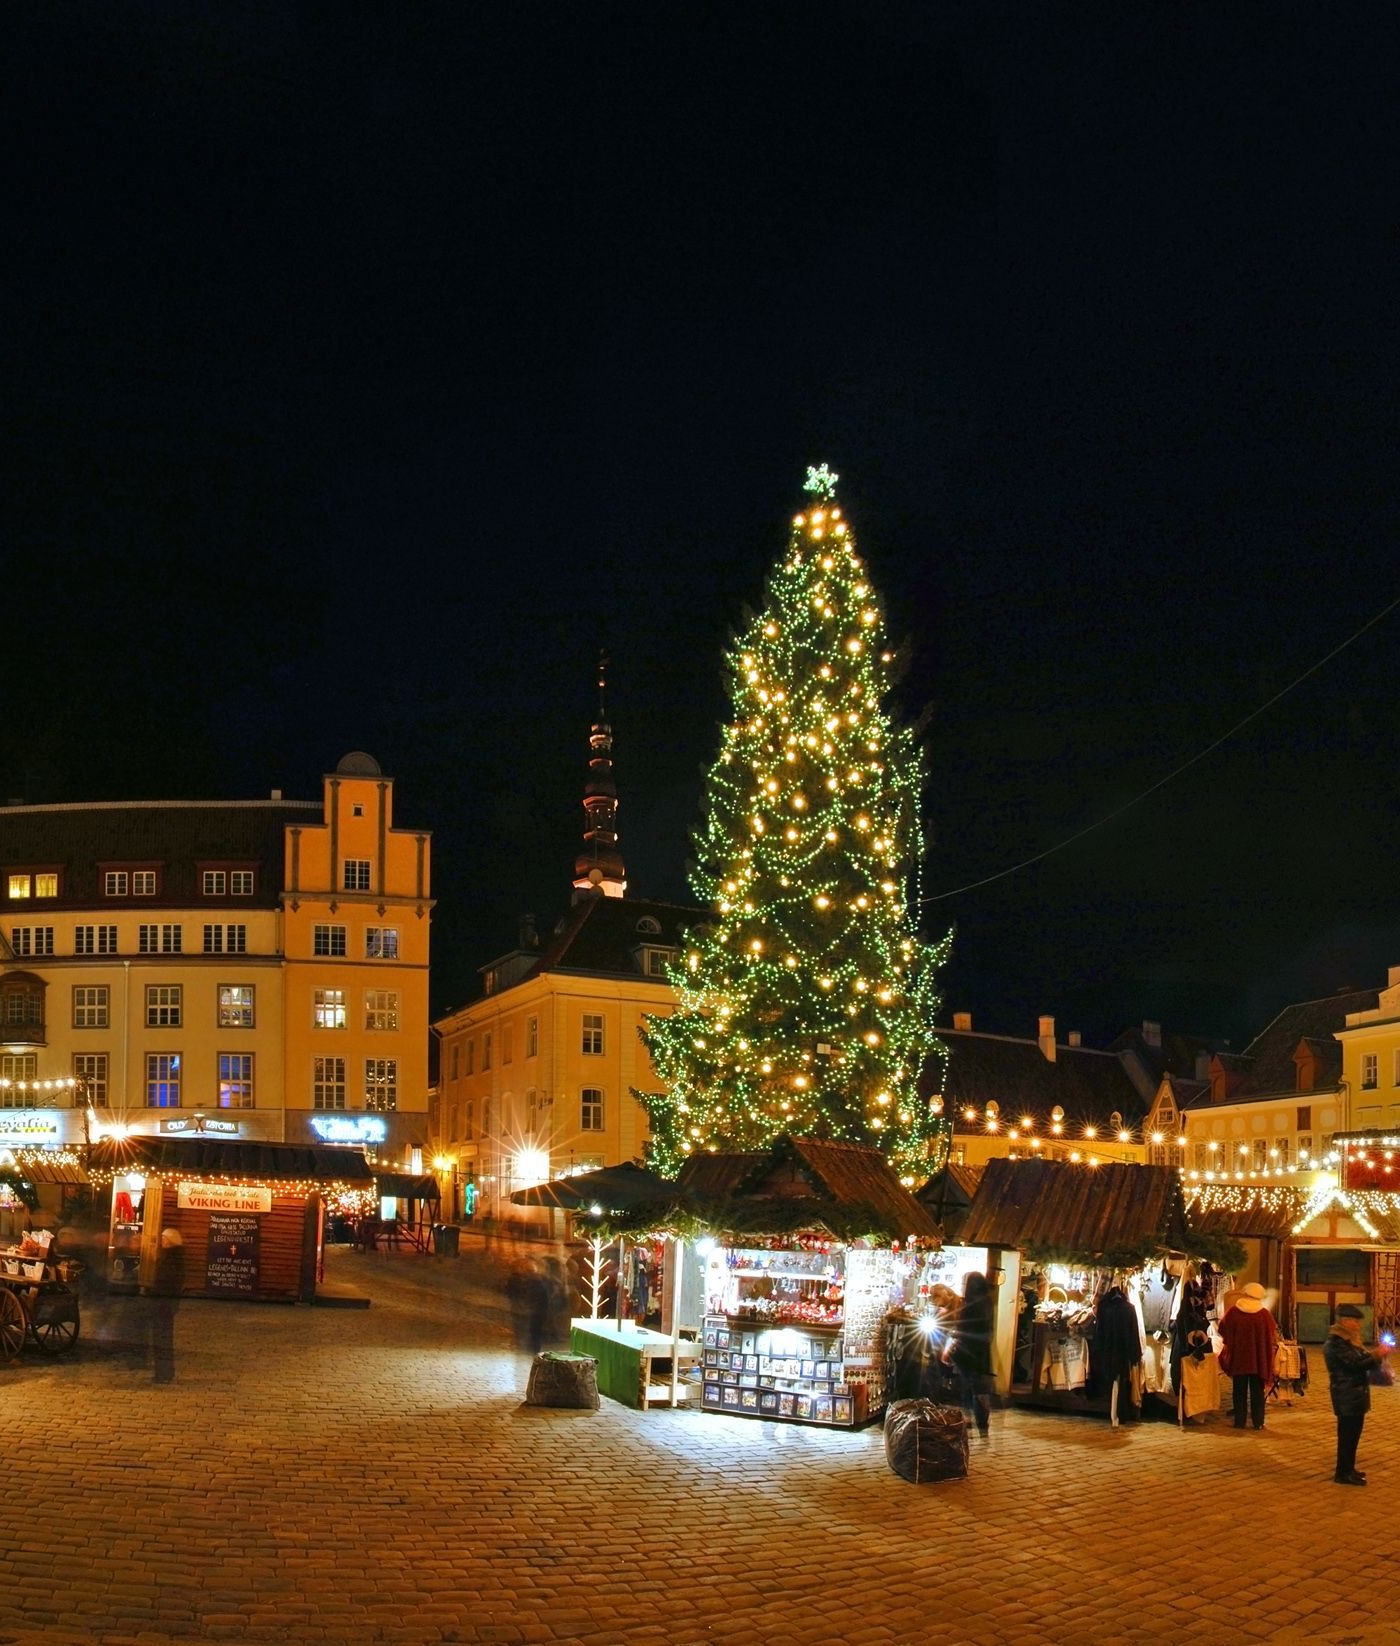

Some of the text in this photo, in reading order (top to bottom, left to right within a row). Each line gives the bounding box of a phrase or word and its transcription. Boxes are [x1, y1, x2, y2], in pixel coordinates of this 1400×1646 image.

[167, 1120, 188, 1130] OLD
[188, 1197, 260, 1210] VIKING LINE
